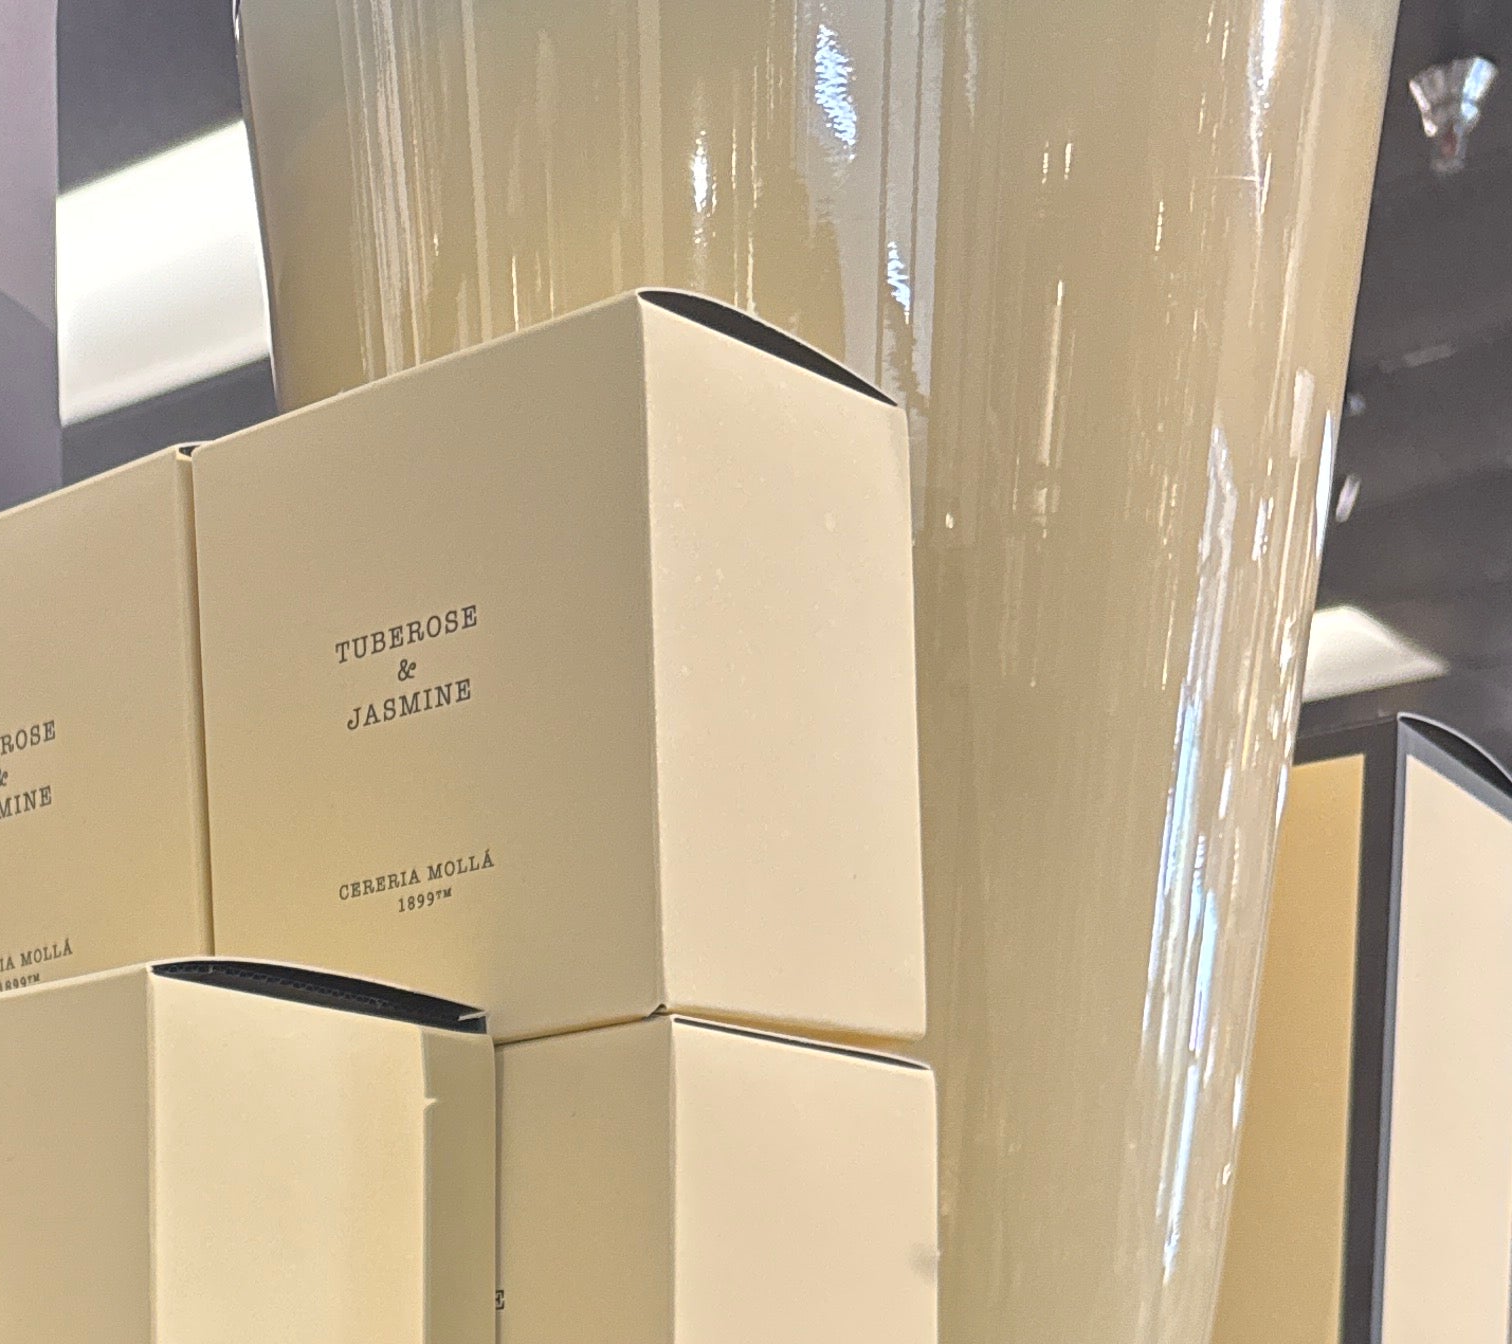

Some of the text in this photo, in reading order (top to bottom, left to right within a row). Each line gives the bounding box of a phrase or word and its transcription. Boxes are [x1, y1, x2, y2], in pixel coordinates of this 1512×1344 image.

[335, 604, 477, 664] TUBEROSE
[397, 658, 417, 682] &
[347, 678, 471, 730] JASMINE
[339, 848, 494, 900] CERERIA MOLLÁ
[20, 937, 73, 967] MOLLÁ
